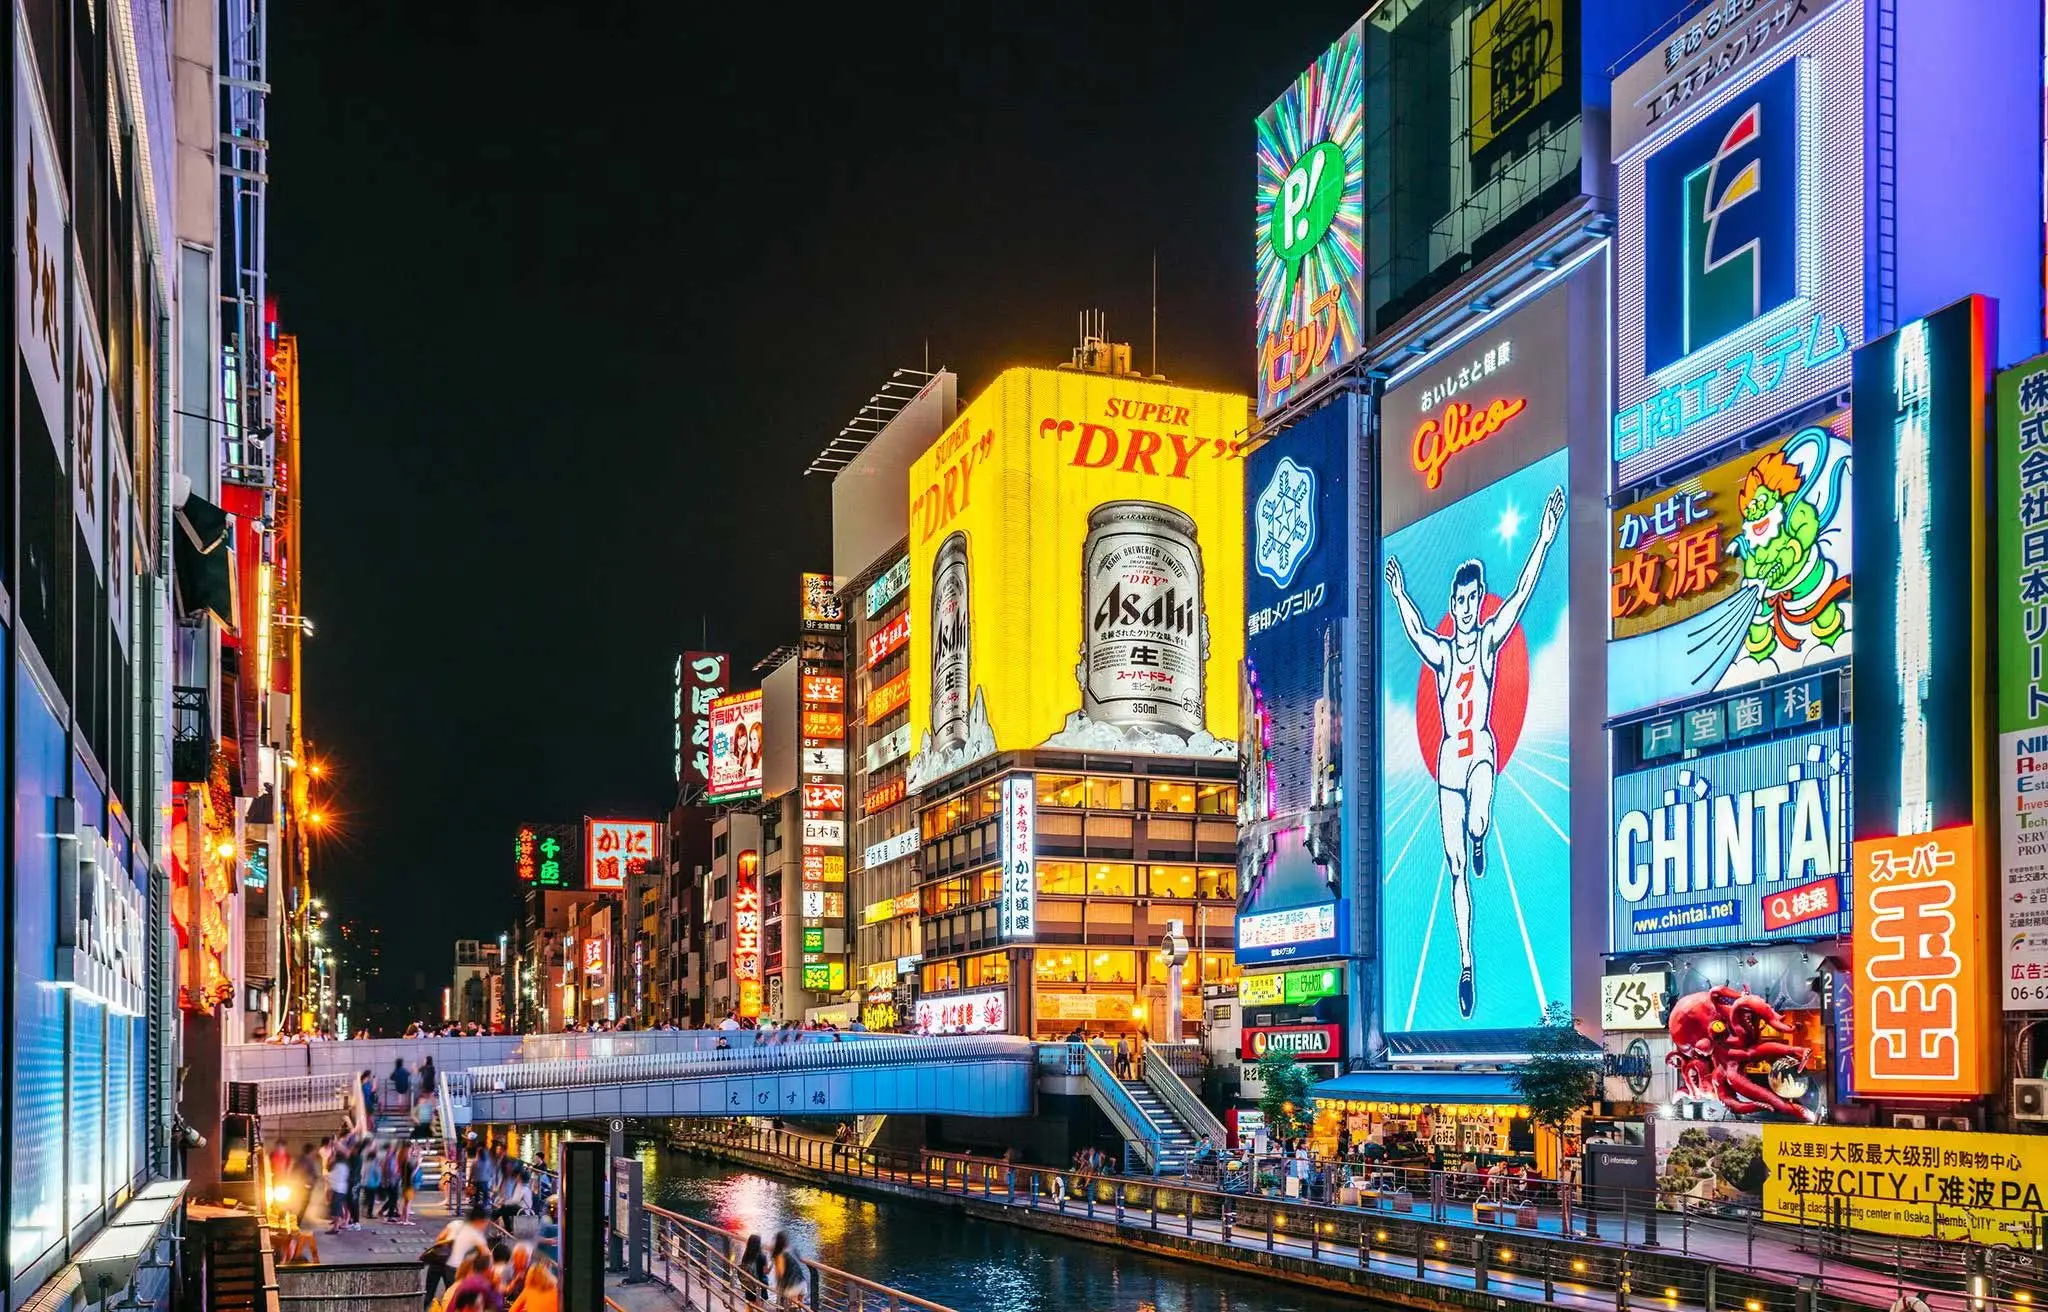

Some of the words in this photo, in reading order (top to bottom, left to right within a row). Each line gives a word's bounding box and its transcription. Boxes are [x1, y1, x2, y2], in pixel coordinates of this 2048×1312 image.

[1265, 284, 1341, 395] ピップ
[1421, 341, 1511, 411] おいしさと健康
[1614, 314, 1853, 462] 日商エステム
[1104, 397, 1191, 427] SUPER
[935, 418, 970, 471] SUPER
[1413, 400, 1526, 488] Glico
[1619, 491, 1715, 549] かぜに
[1123, 545, 1161, 558] BREWERIES
[1162, 554, 1183, 579] LIMITED
[1611, 522, 1723, 618] 改源
[1094, 582, 1193, 638] Asahi
[1248, 583, 1325, 635] 雪印メグミルク
[934, 607, 967, 671] Asahi
[804, 667, 818, 675] 8F
[1130, 645, 1159, 667] 生
[1116, 670, 1174, 684] スーパードライ
[805, 703, 818, 711] 7F
[1132, 703, 1158, 715] 350ml
[1456, 664, 1475, 758] グリコ
[1807, 705, 1820, 719] 3F
[804, 739, 819, 747] 6F
[804, 811, 819, 819] 4F
[1016, 804, 1028, 854] 本場の味
[597, 828, 648, 853] かに
[806, 824, 840, 839] 白木屋
[540, 837, 560, 880] 千房
[804, 848, 818, 856] 3F
[1871, 843, 1954, 881] スーパー
[1015, 859, 1030, 930] かに道楽
[1791, 886, 1829, 913] 検索
[734, 887, 759, 980] 大阪王将
[805, 919, 818, 927] 1F
[1823, 973, 1833, 1010] 2F
[1866, 880, 1961, 1080] 玉出
[942, 1003, 973, 1026] かに道楽
[1614, 982, 1652, 1020] くくる
[1267, 1030, 1322, 1050] LOTTERIA
[1243, 1068, 1265, 1082] たこ
[729, 1090, 826, 1105] えびす橋
[1610, 1157, 1637, 1165] information
[1866, 1208, 1891, 1220] center
[1894, 1209, 1901, 1220] in
[1904, 1209, 1932, 1224] Osaka.
